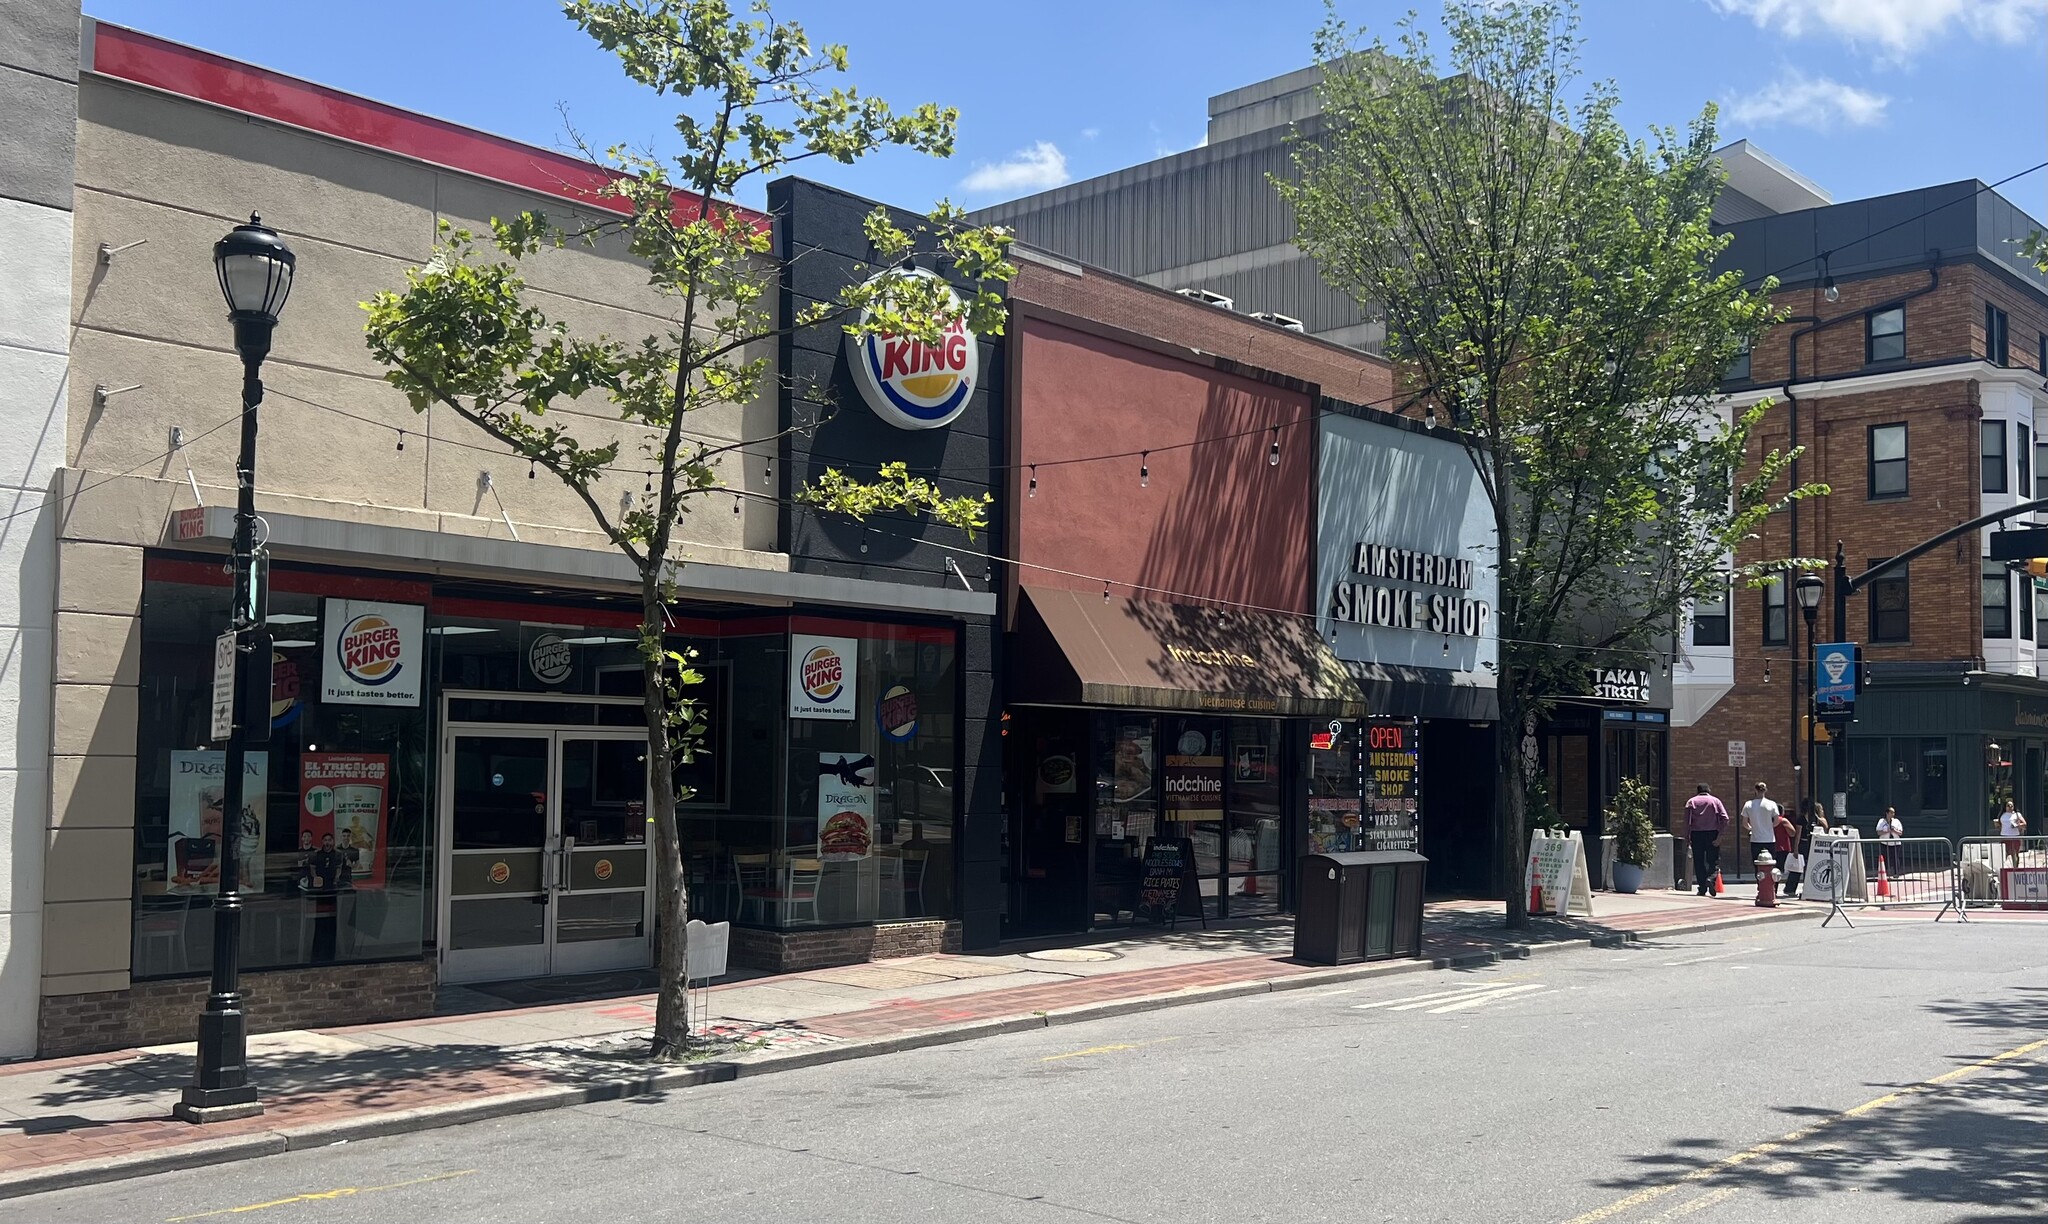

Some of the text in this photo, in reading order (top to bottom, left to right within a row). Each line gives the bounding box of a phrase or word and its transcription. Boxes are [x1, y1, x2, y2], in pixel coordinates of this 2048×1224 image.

[882, 335, 967, 380] KING
[180, 519, 204, 539] KING
[1353, 542, 1474, 590] AMSTERDAM
[1333, 581, 1491, 636] SMOKE SHOP
[344, 628, 399, 652] BURGER
[346, 640, 401, 670] KING
[533, 643, 570, 660] BURGER
[535, 651, 571, 673] KING
[804, 656, 841, 676] BURGER
[805, 667, 842, 692] KING
[1594, 669, 1637, 685] TAKA
[327, 688, 415, 699] It just tastes better.
[1593, 684, 1639, 700] STREET
[800, 706, 812, 714] just
[813, 706, 832, 714] tastes
[1249, 699, 1277, 710] cuisine
[1370, 727, 1402, 749] OPEN
[304, 761, 321, 770] EL
[1369, 752, 1415, 767] AMSTERDAM
[179, 760, 260, 776] DRAN
[304, 770, 386, 779] COLLECTOR'S CUP
[1375, 769, 1410, 782] SMOKE
[1165, 775, 1222, 792] indochine
[1381, 783, 1404, 796] SHOP
[825, 794, 867, 805] DRAGON
[1374, 814, 1398, 826] VAPES
[1387, 830, 1415, 839] MINIMUM
[1376, 840, 1410, 851] CIGARETTES
[1544, 843, 1562, 852] 369
[1144, 876, 1160, 887] RICE
